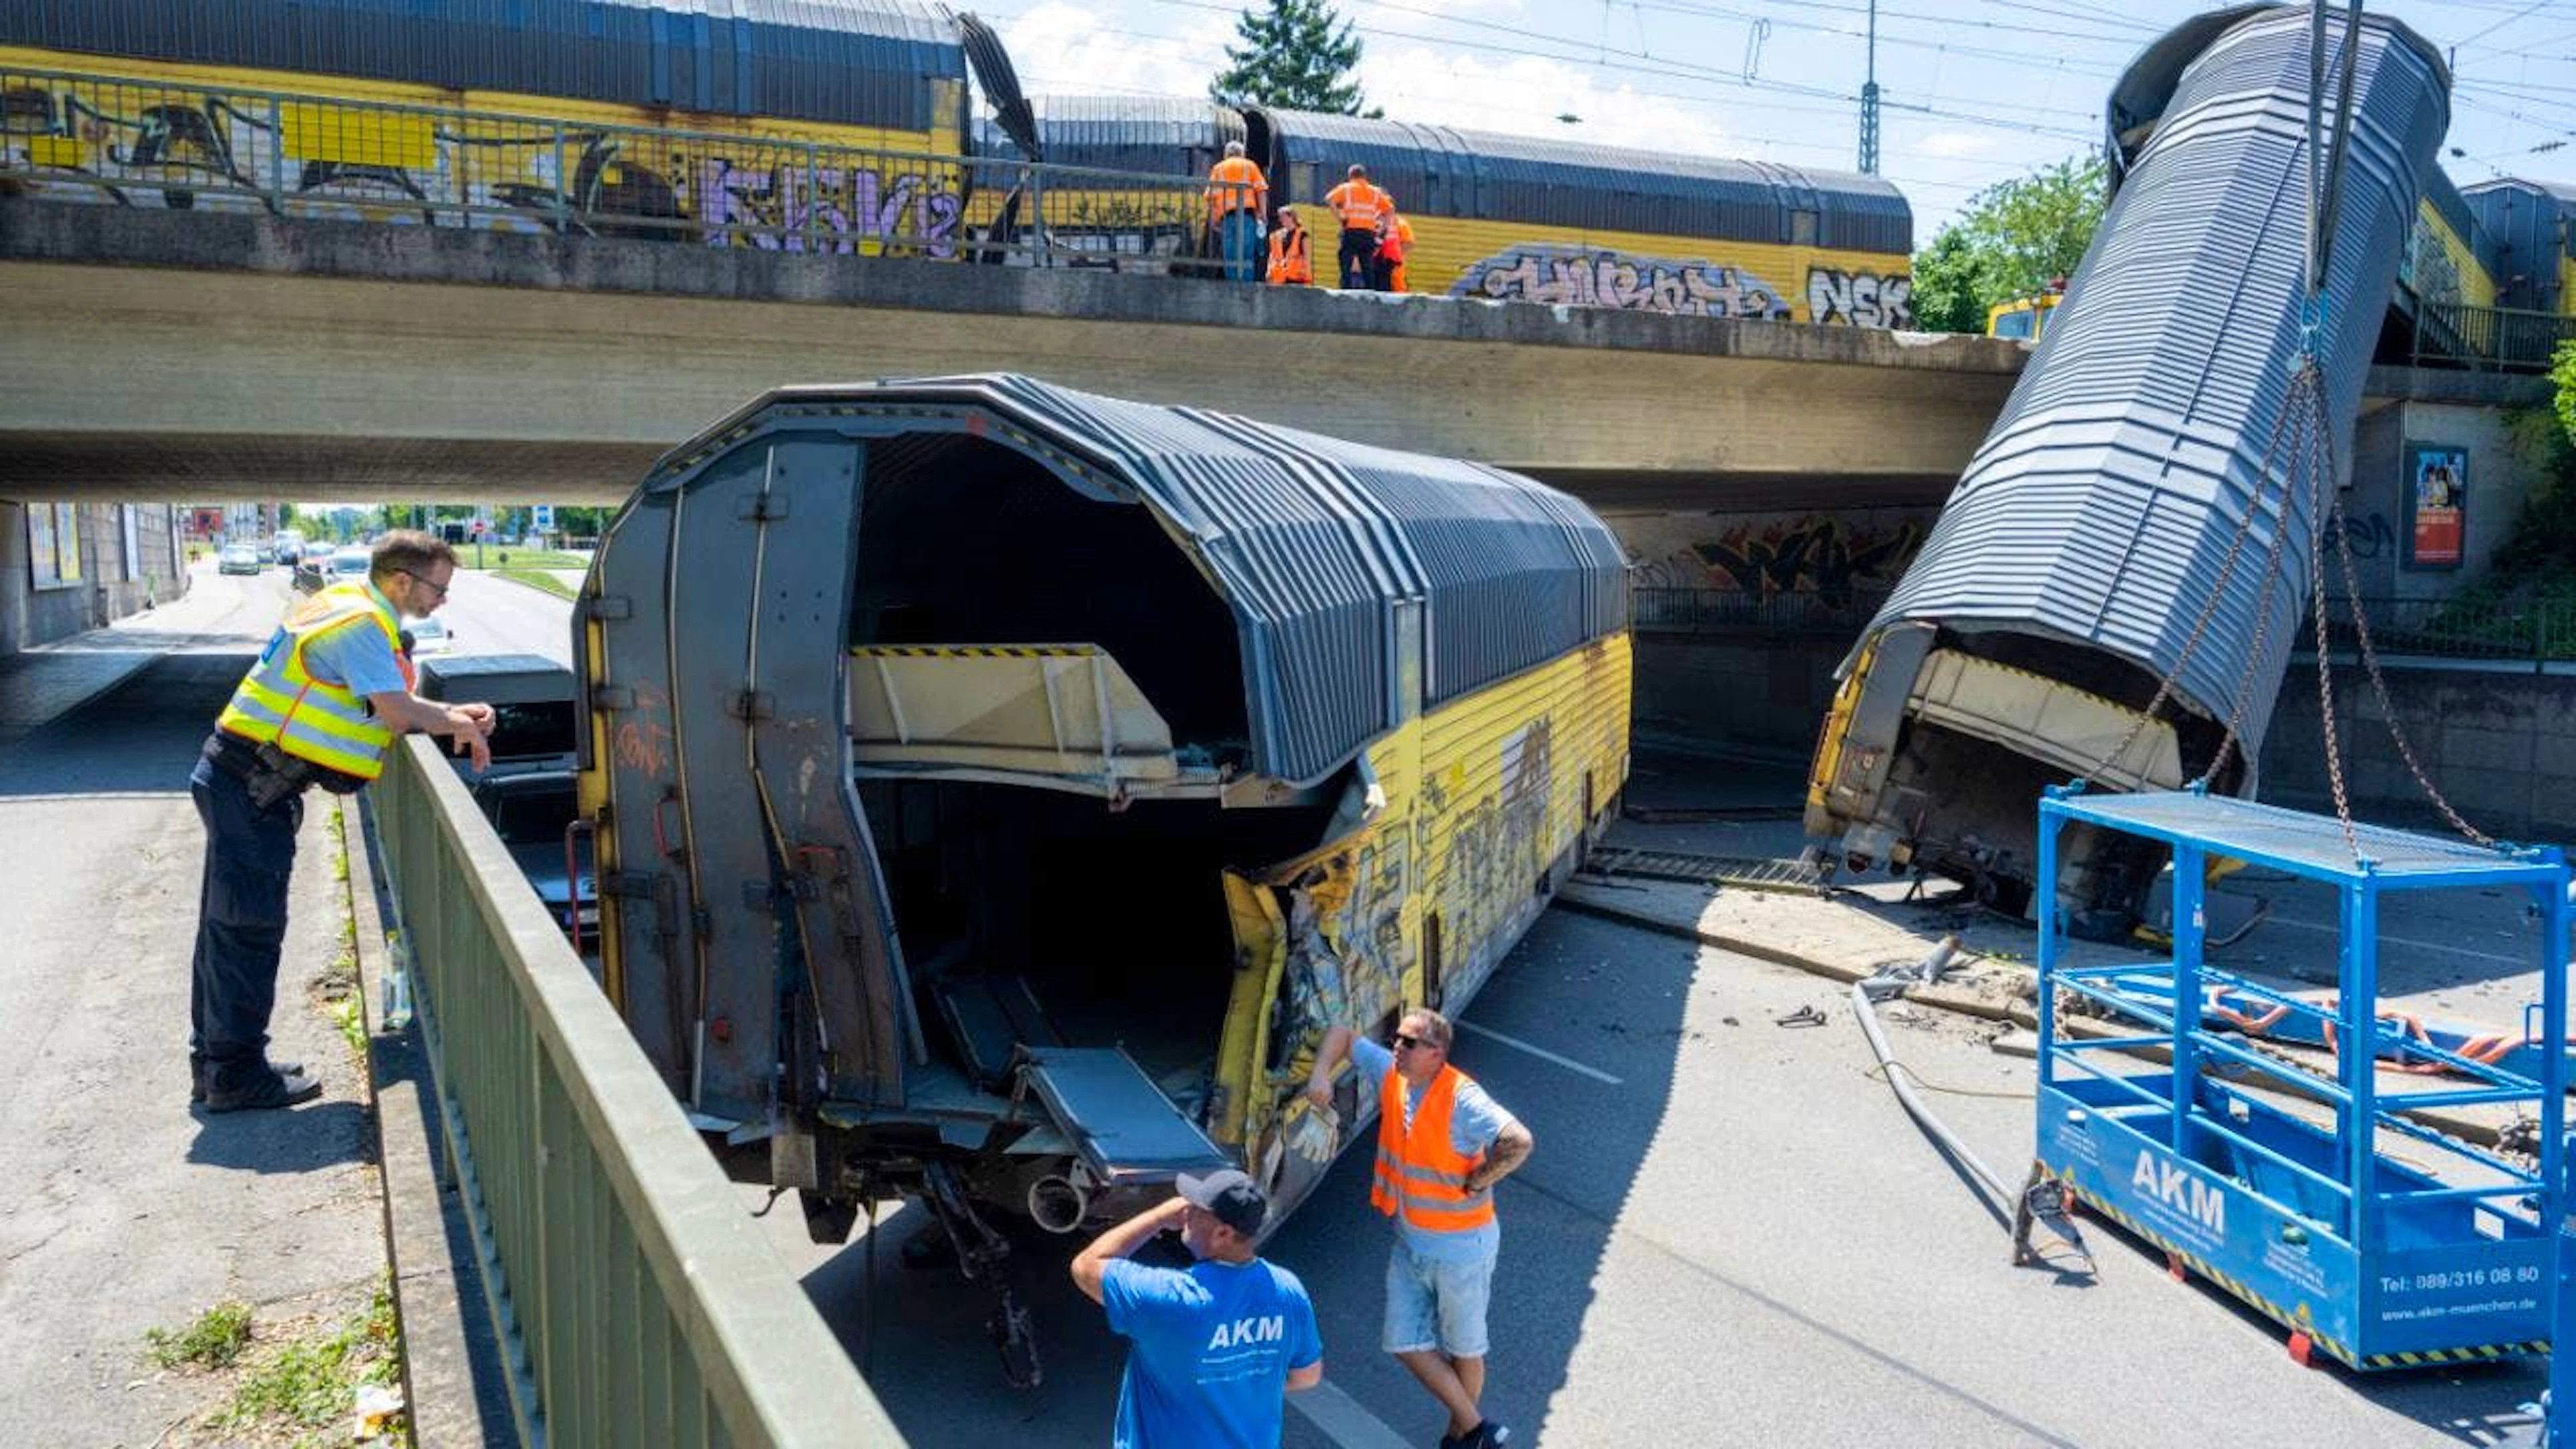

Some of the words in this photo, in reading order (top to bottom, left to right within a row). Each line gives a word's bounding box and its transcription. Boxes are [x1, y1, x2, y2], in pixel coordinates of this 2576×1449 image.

[2132, 1149, 2225, 1234] AKM
[2379, 1277, 2410, 1293] Tel:
[2416, 1269, 2485, 1289] 089/316
[2489, 1267, 2511, 1285] 08
[2516, 1265, 2539, 1283] 80
[1208, 1315, 1283, 1351] AKM
